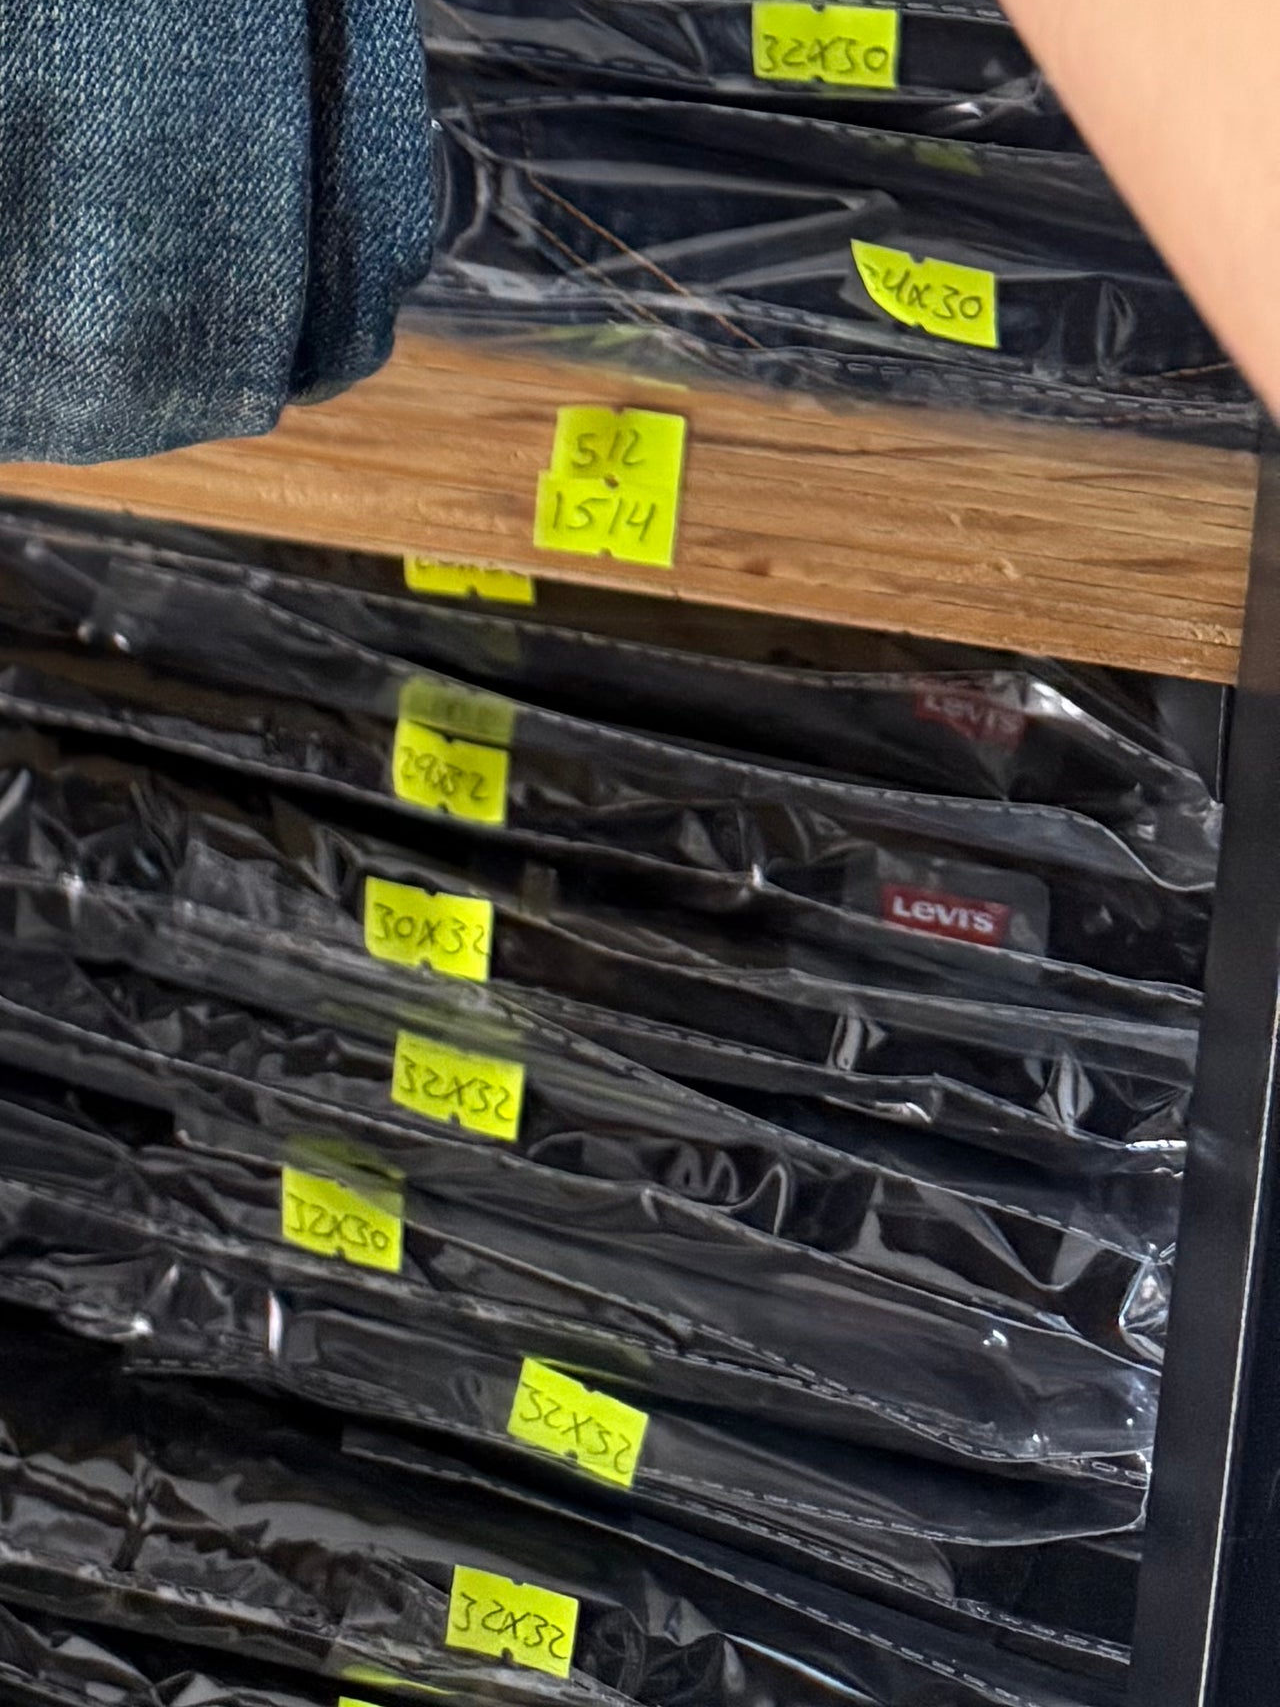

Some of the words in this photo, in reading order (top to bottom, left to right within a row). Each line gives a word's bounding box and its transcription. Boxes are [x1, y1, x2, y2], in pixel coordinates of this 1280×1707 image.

[570, 428, 647, 470] 512
[551, 490, 658, 543] 1514
[450, 1590, 569, 1660] 32X32
